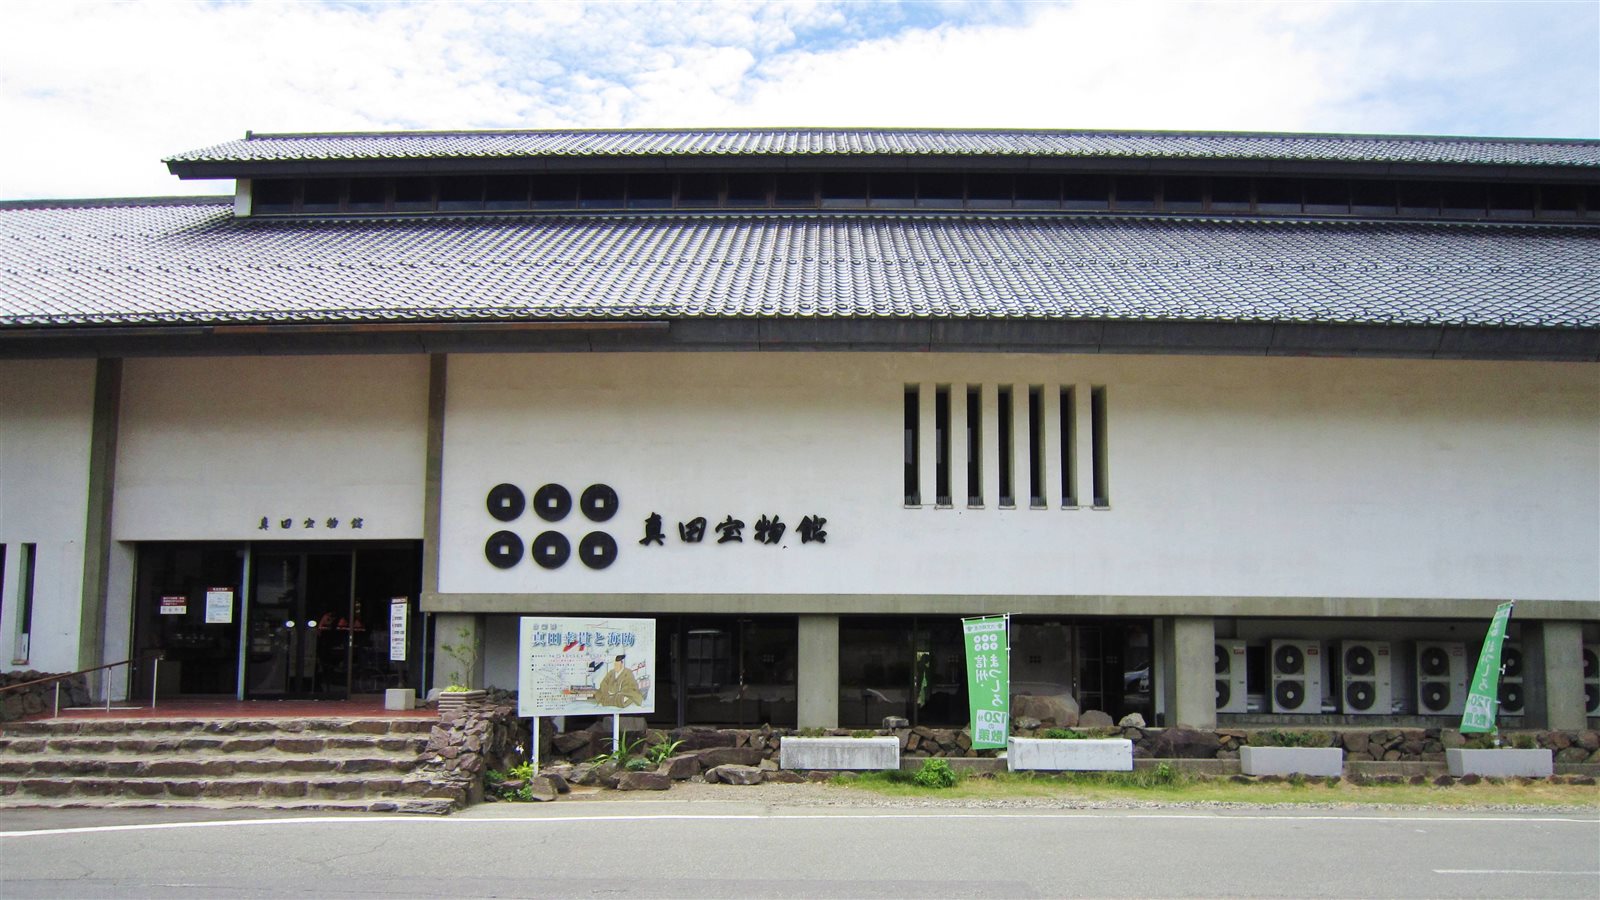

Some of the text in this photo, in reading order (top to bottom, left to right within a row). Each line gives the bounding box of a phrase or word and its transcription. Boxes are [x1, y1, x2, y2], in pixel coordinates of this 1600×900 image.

[258, 516, 364, 530] 真田宝物館
[639, 511, 827, 546] 真田宝物館
